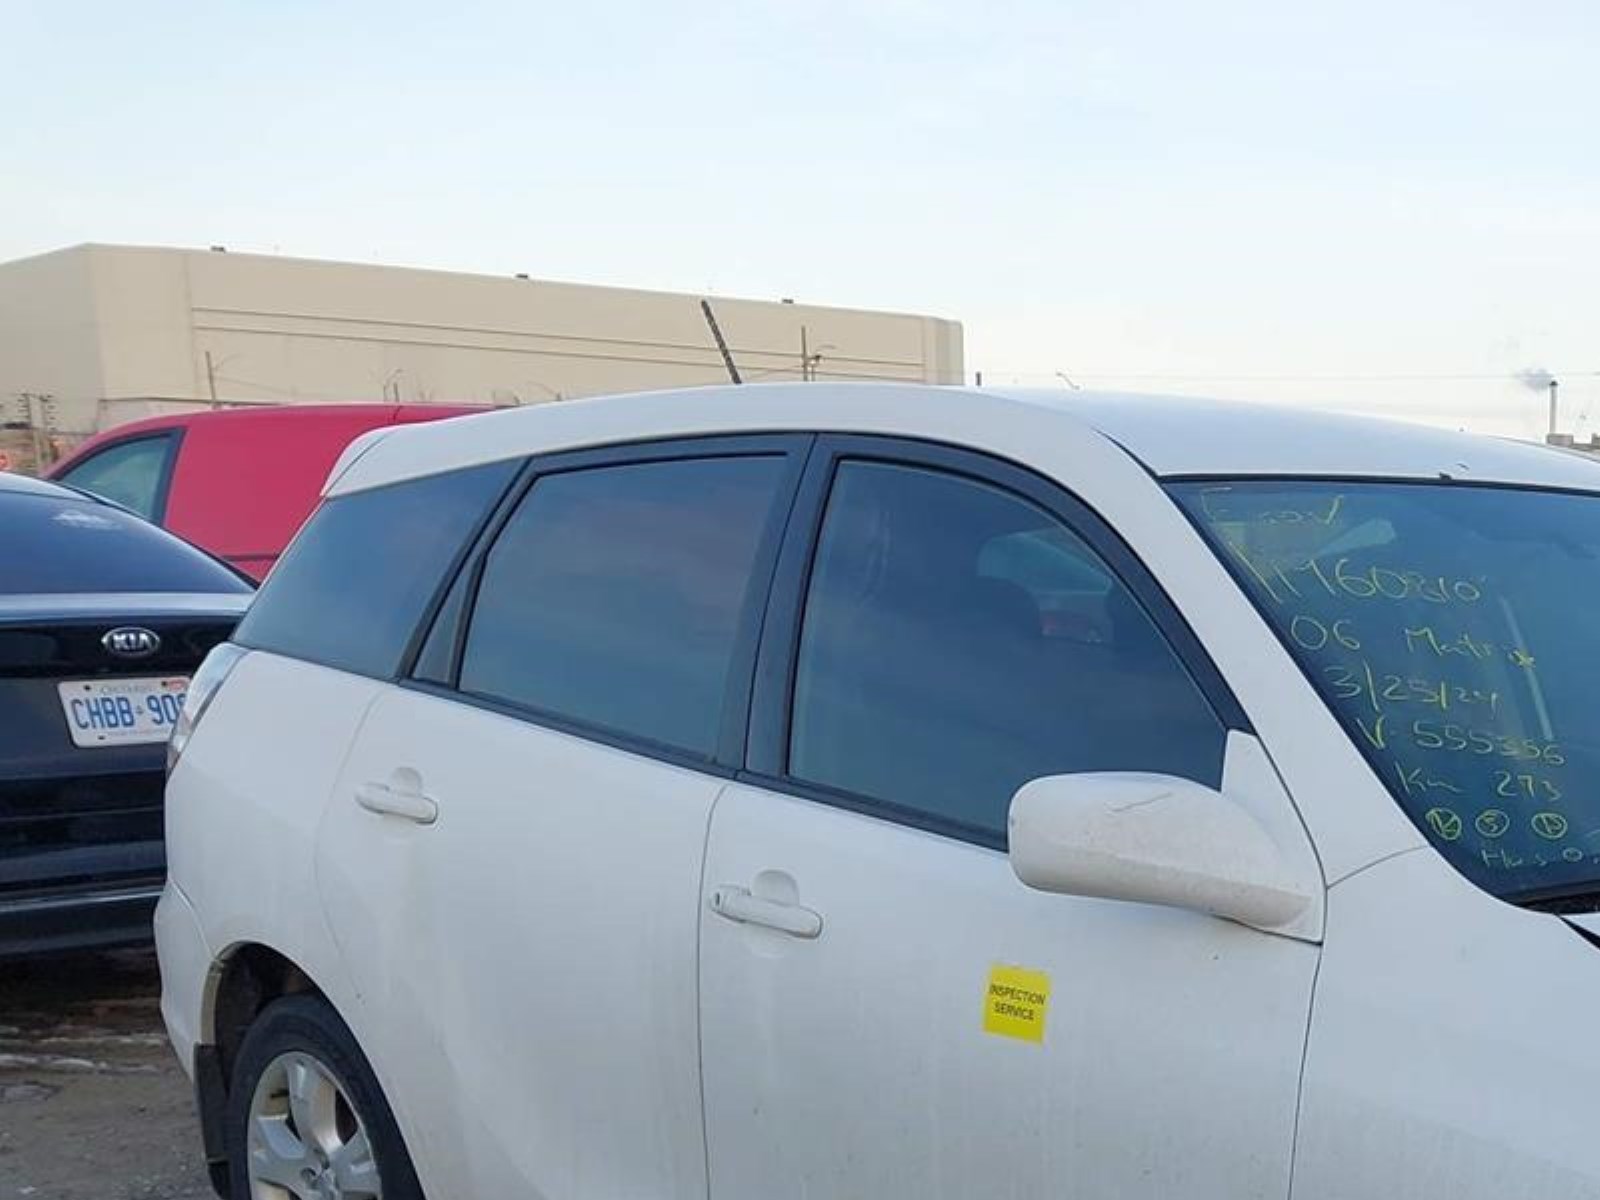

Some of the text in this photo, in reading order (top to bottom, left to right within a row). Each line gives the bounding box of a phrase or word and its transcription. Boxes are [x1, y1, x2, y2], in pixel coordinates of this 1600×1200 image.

[1291, 614, 1361, 651] 06
[70, 696, 135, 730] CHBB
[994, 1002, 1035, 1020] SERVICE
